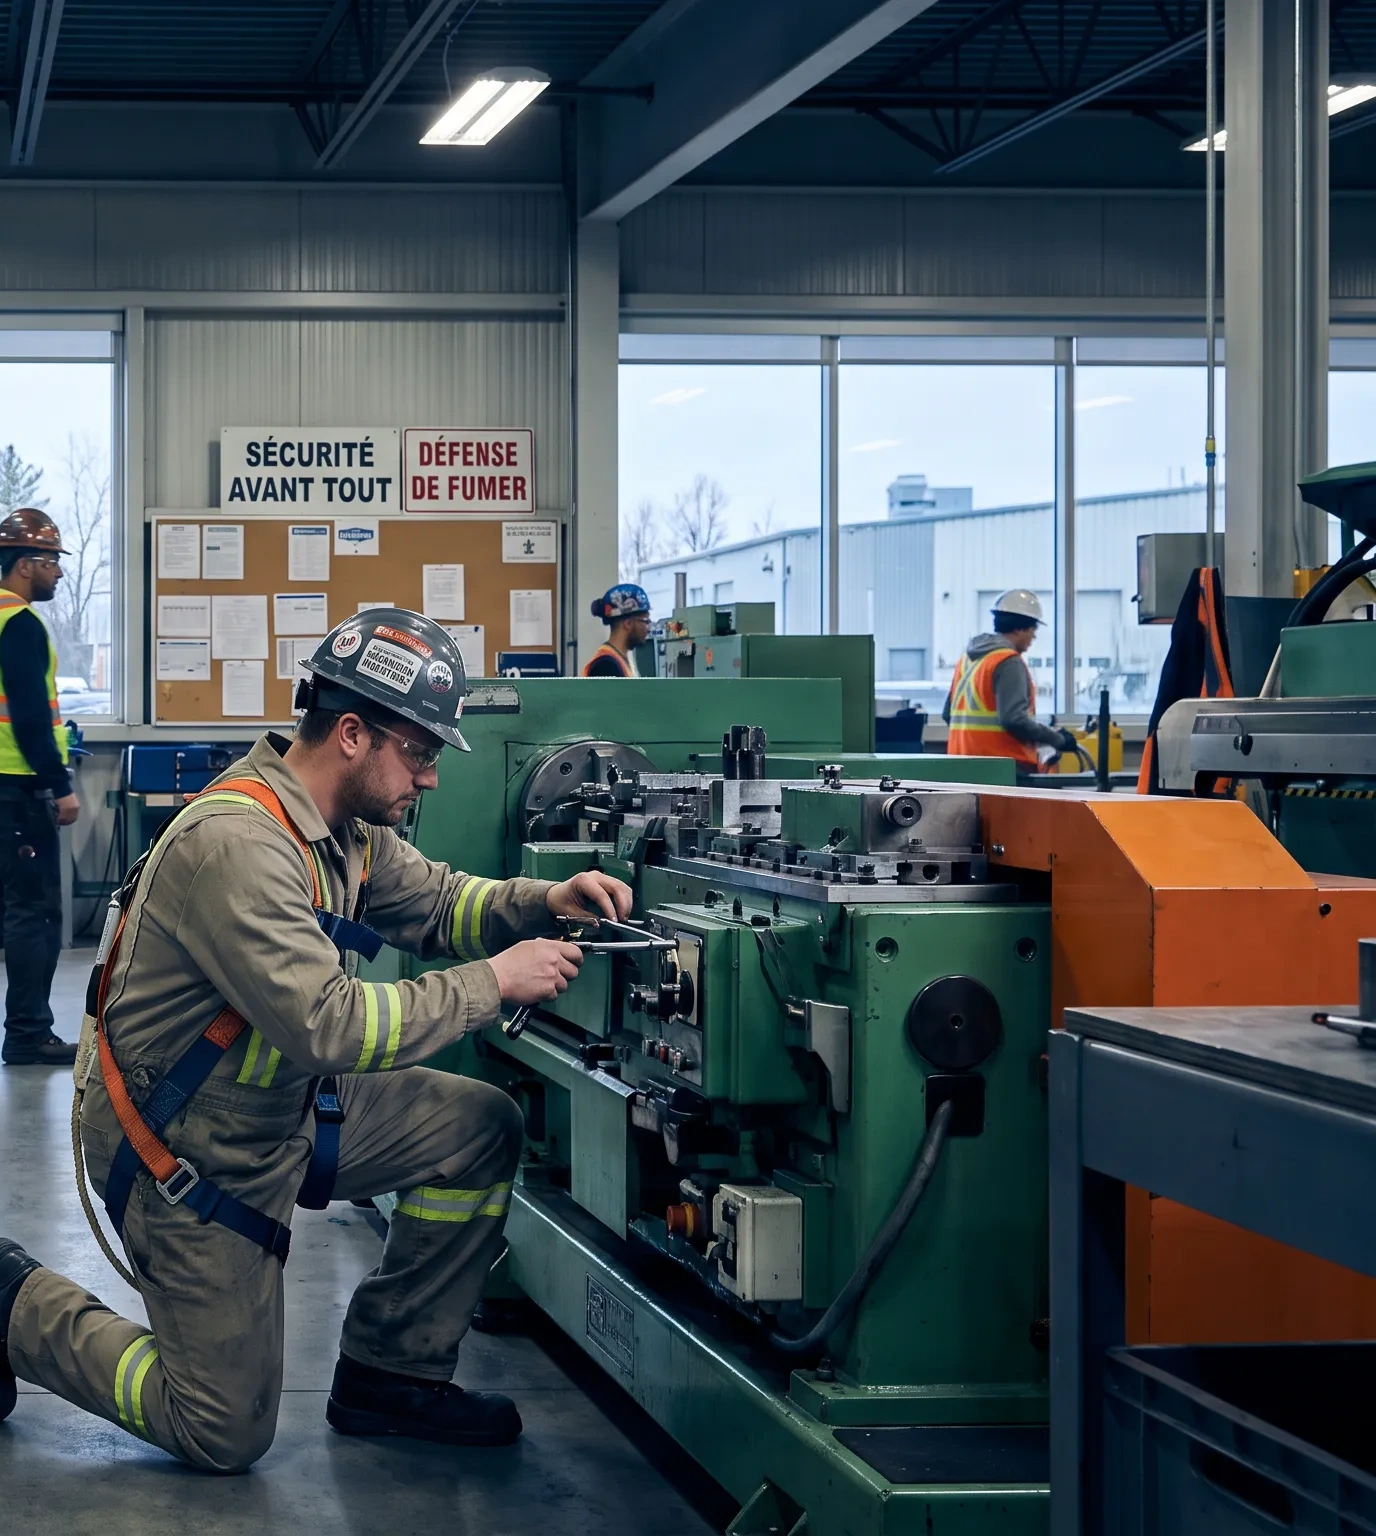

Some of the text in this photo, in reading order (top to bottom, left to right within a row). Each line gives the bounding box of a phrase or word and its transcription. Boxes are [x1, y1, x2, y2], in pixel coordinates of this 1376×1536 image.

[246, 436, 374, 467] SÉCURITÉ
[420, 436, 517, 467] DÉFENSE
[228, 477, 392, 502] AVANT TOUT
[412, 476, 526, 500] DE FUMER
